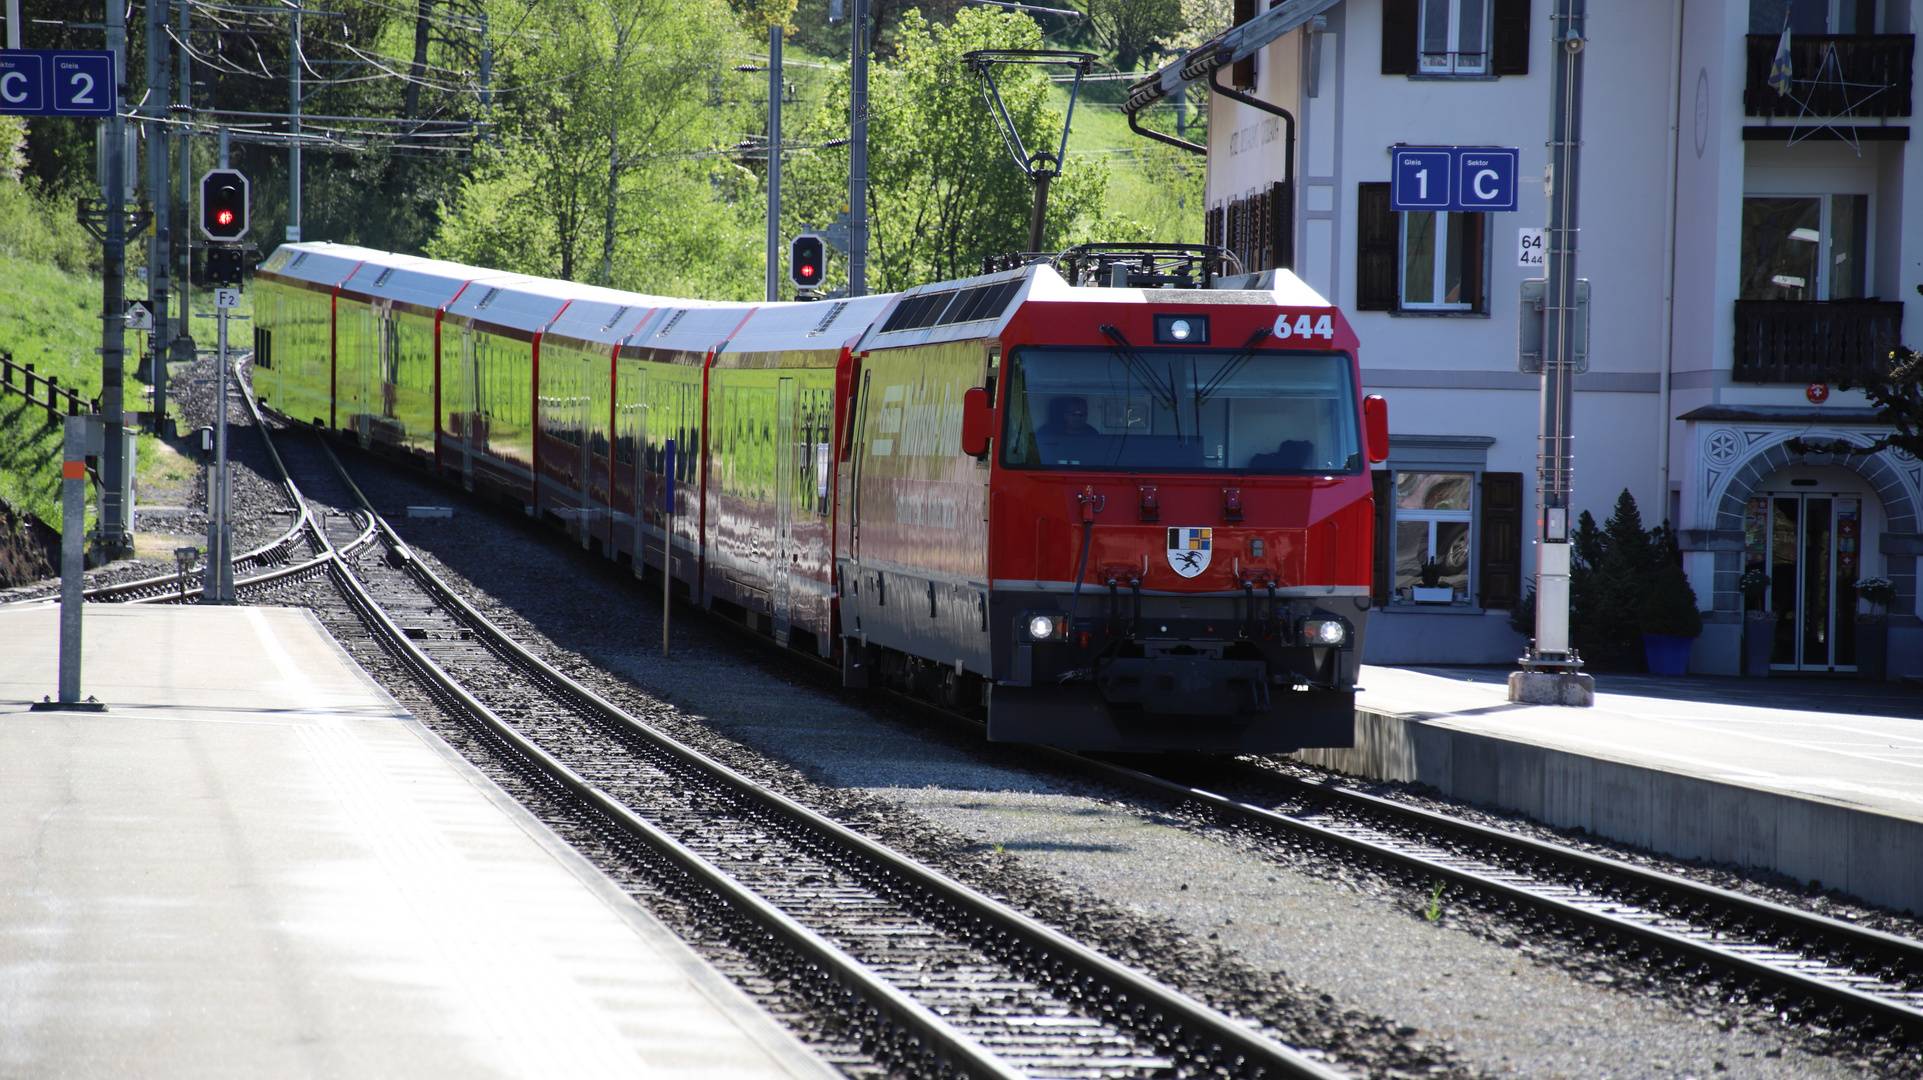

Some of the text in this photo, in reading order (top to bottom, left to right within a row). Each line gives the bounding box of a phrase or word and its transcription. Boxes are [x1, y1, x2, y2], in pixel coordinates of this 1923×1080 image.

[0, 71, 28, 103] C
[70, 72, 94, 104] 2
[1415, 169, 1428, 199] 1
[1473, 169, 1499, 200] C
[1521, 235, 1542, 249] 64
[1273, 314, 1334, 339] 644
